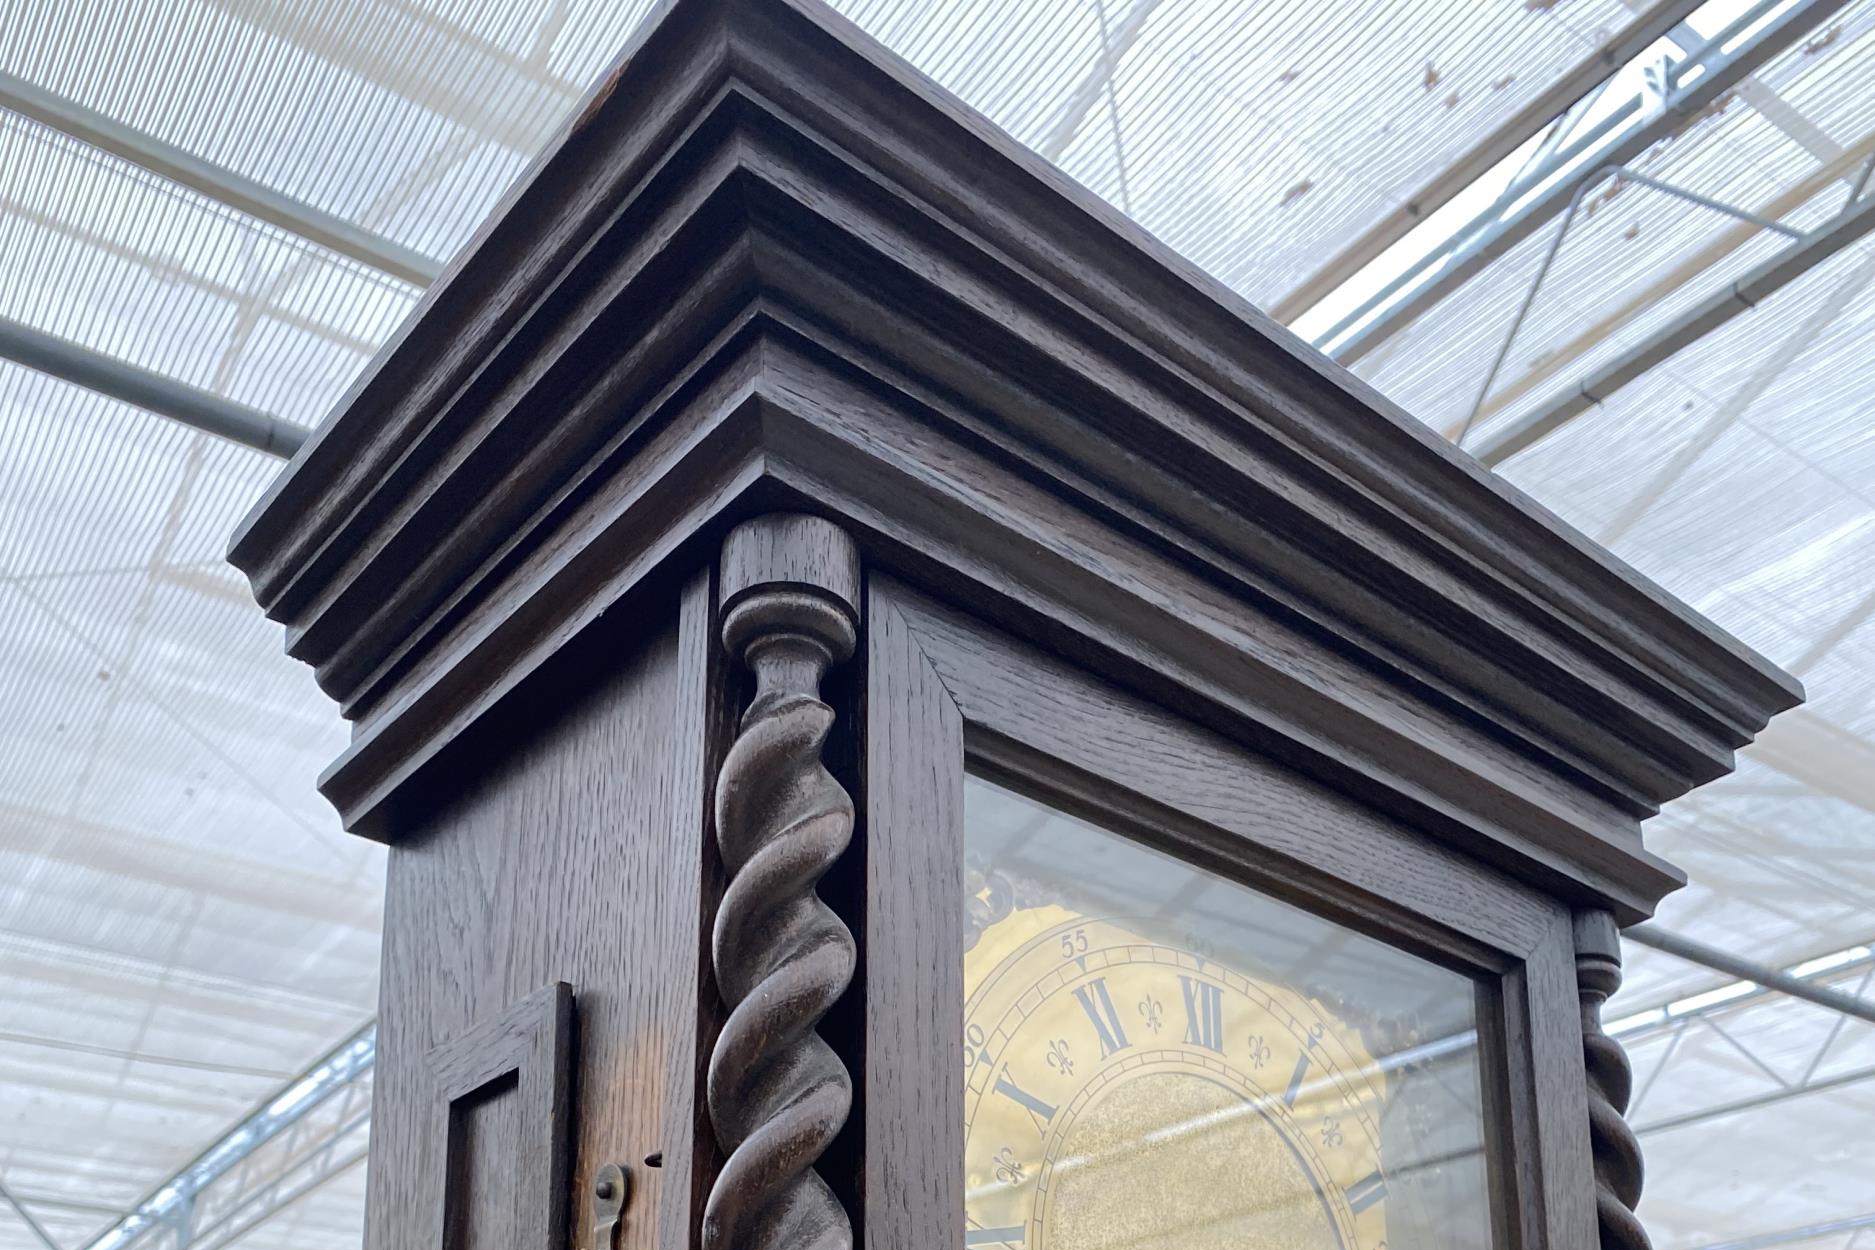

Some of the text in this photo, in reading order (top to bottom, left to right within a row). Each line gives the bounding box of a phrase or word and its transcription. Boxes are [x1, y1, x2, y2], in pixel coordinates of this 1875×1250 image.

[1061, 930, 1088, 958] 55
[1071, 977, 1132, 1061] XI
[1177, 975, 1227, 1058] XII
[992, 1062, 1060, 1140] X
